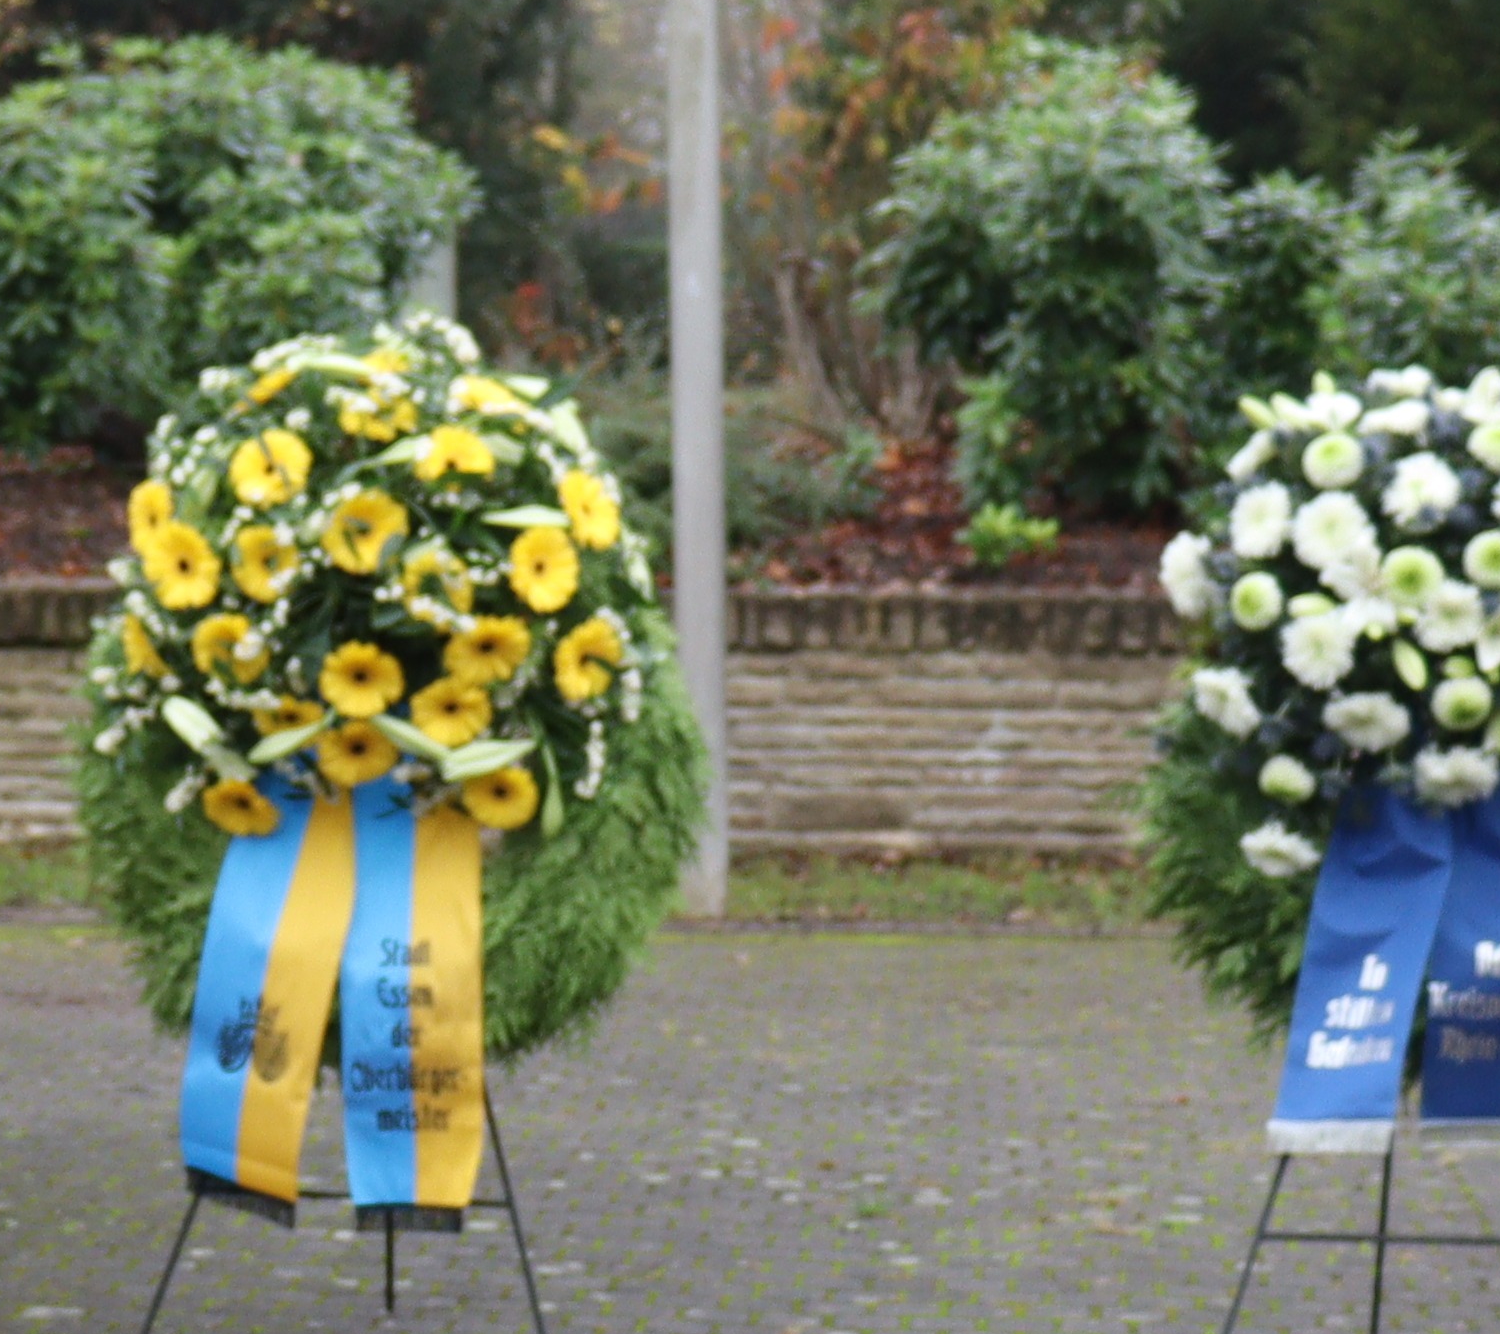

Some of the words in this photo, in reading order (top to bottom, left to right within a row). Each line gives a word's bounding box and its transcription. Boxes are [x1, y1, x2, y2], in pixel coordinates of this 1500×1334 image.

[381, 938, 430, 966] Stadt
[377, 977, 432, 1008] Essen
[392, 1020, 419, 1047] der
[377, 1104, 448, 1131] meister
